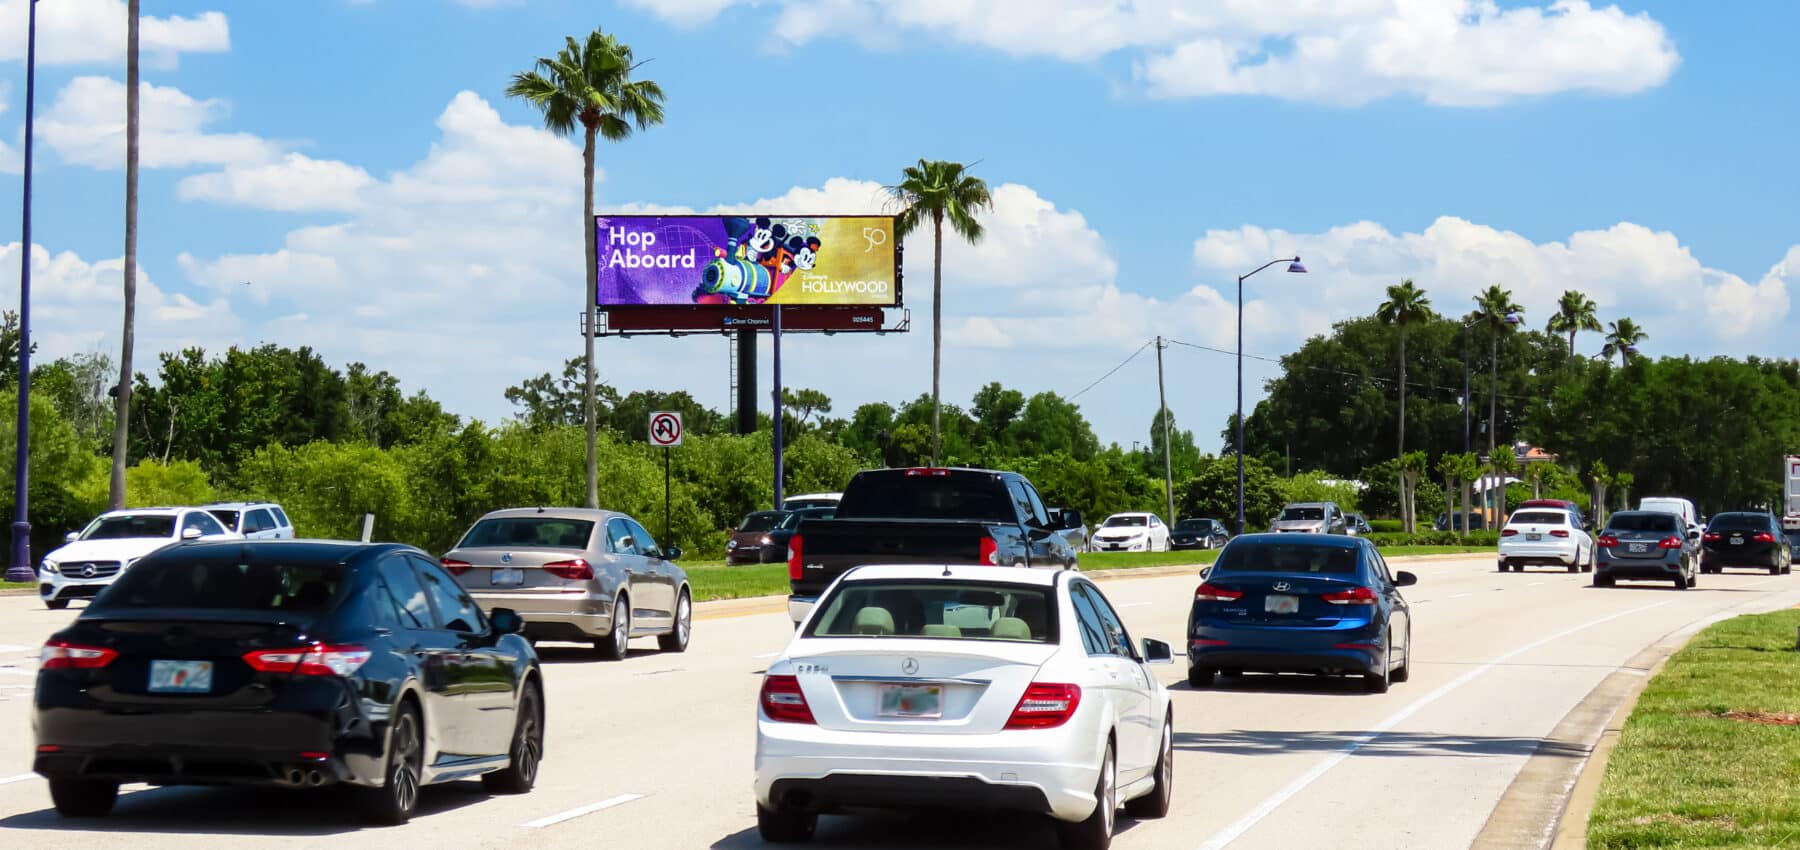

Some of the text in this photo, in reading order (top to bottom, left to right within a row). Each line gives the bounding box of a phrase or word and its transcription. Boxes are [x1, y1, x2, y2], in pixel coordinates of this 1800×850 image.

[610, 226, 656, 251] Hop
[863, 227, 887, 253] 50
[609, 248, 695, 268] Aboard
[802, 281, 888, 293] HOLLYWOOD
